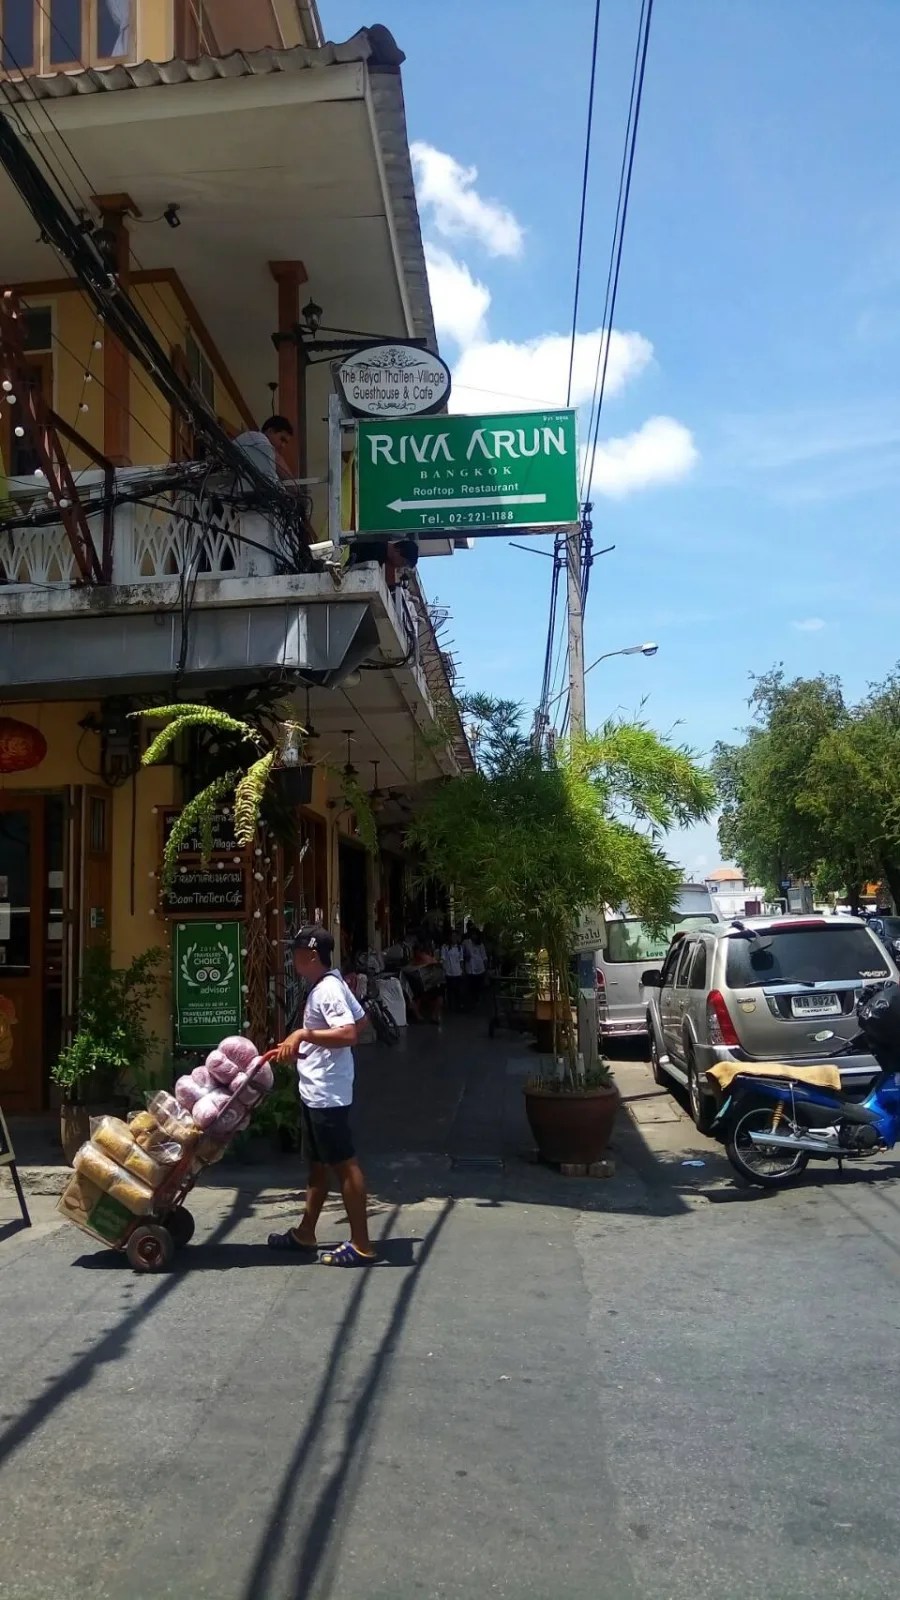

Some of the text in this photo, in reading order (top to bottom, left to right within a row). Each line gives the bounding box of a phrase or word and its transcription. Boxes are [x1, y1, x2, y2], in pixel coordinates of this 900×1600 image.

[342, 370, 355, 383] The
[360, 370, 381, 388] Royal
[353, 386, 433, 400] Guesthouse & Cafe
[366, 427, 568, 466] RIVA ARUN
[420, 466, 513, 479] BANGKOK
[413, 482, 519, 496] Rooftop Restaurant
[419, 511, 514, 525] Tel. 02-221-1188
[193, 957, 221, 965] CHOICE
[646, 950, 664, 958] Love
[182, 1015, 237, 1025] DESTINATION
